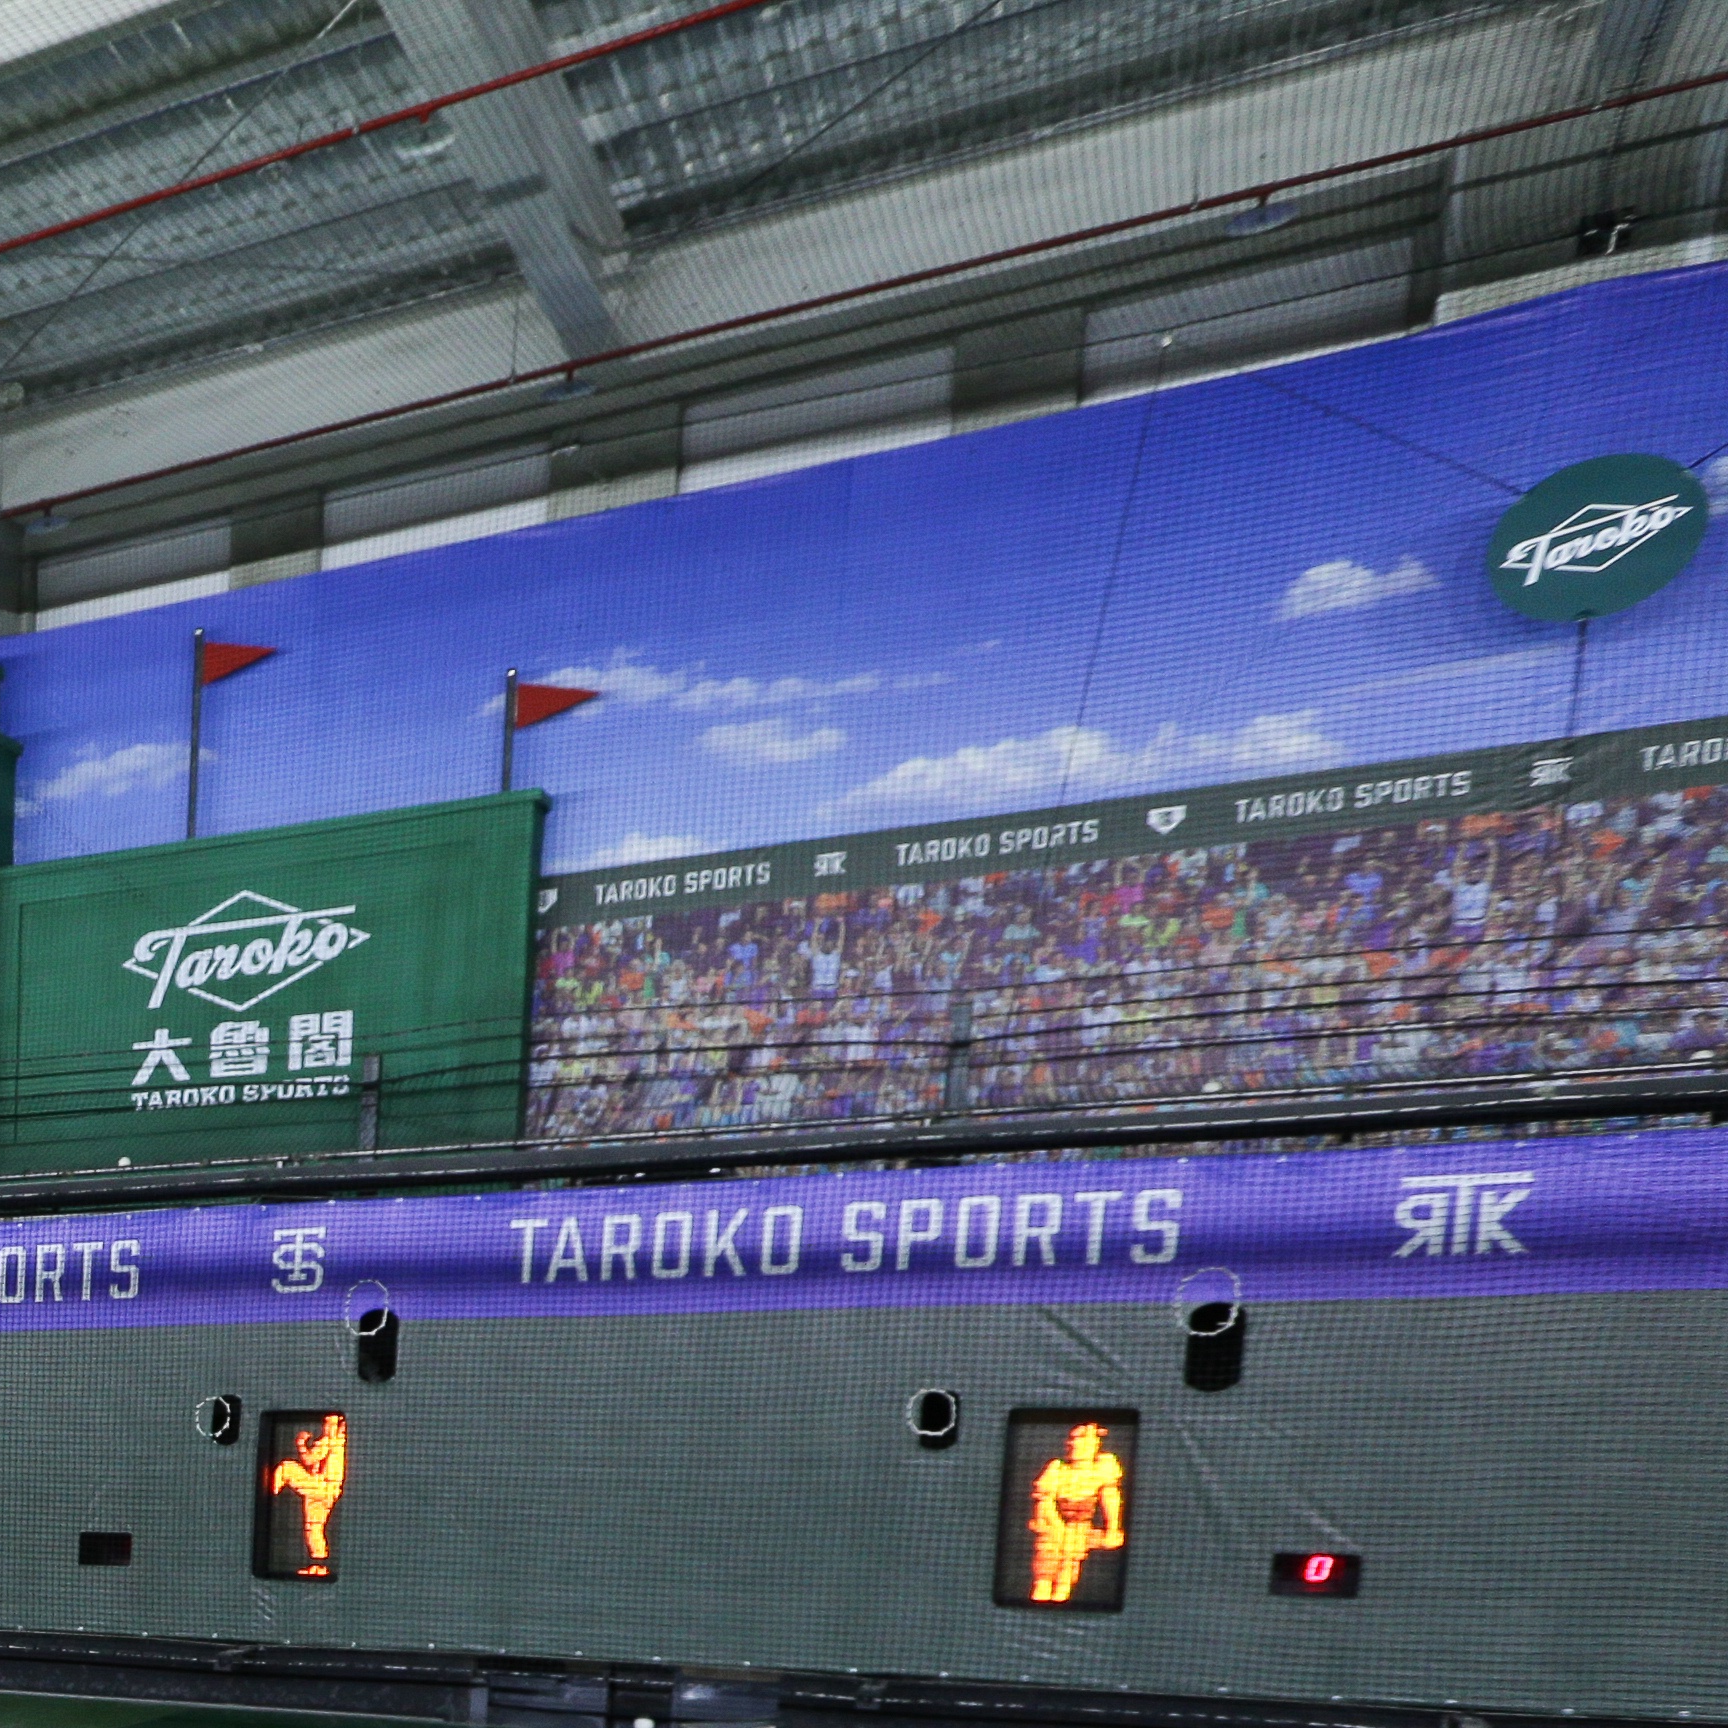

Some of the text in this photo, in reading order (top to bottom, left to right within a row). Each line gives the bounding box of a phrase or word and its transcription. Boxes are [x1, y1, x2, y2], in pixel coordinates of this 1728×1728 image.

[1506, 493, 1679, 587] Taroko
[1639, 737, 1728, 773] TARO
[1235, 770, 1474, 824] TAROKO SPORTS
[895, 818, 1101, 866] TAROKO SPORTS
[594, 861, 772, 906] TAROKO SPORTS
[133, 904, 357, 1010] Taroko
[131, 1009, 354, 1087] 大魯閣
[131, 1074, 351, 1111] TAROKO SPORTS
[509, 1188, 1185, 1285] TAROKO SPORTS
[1303, 1554, 1335, 1583] 0
